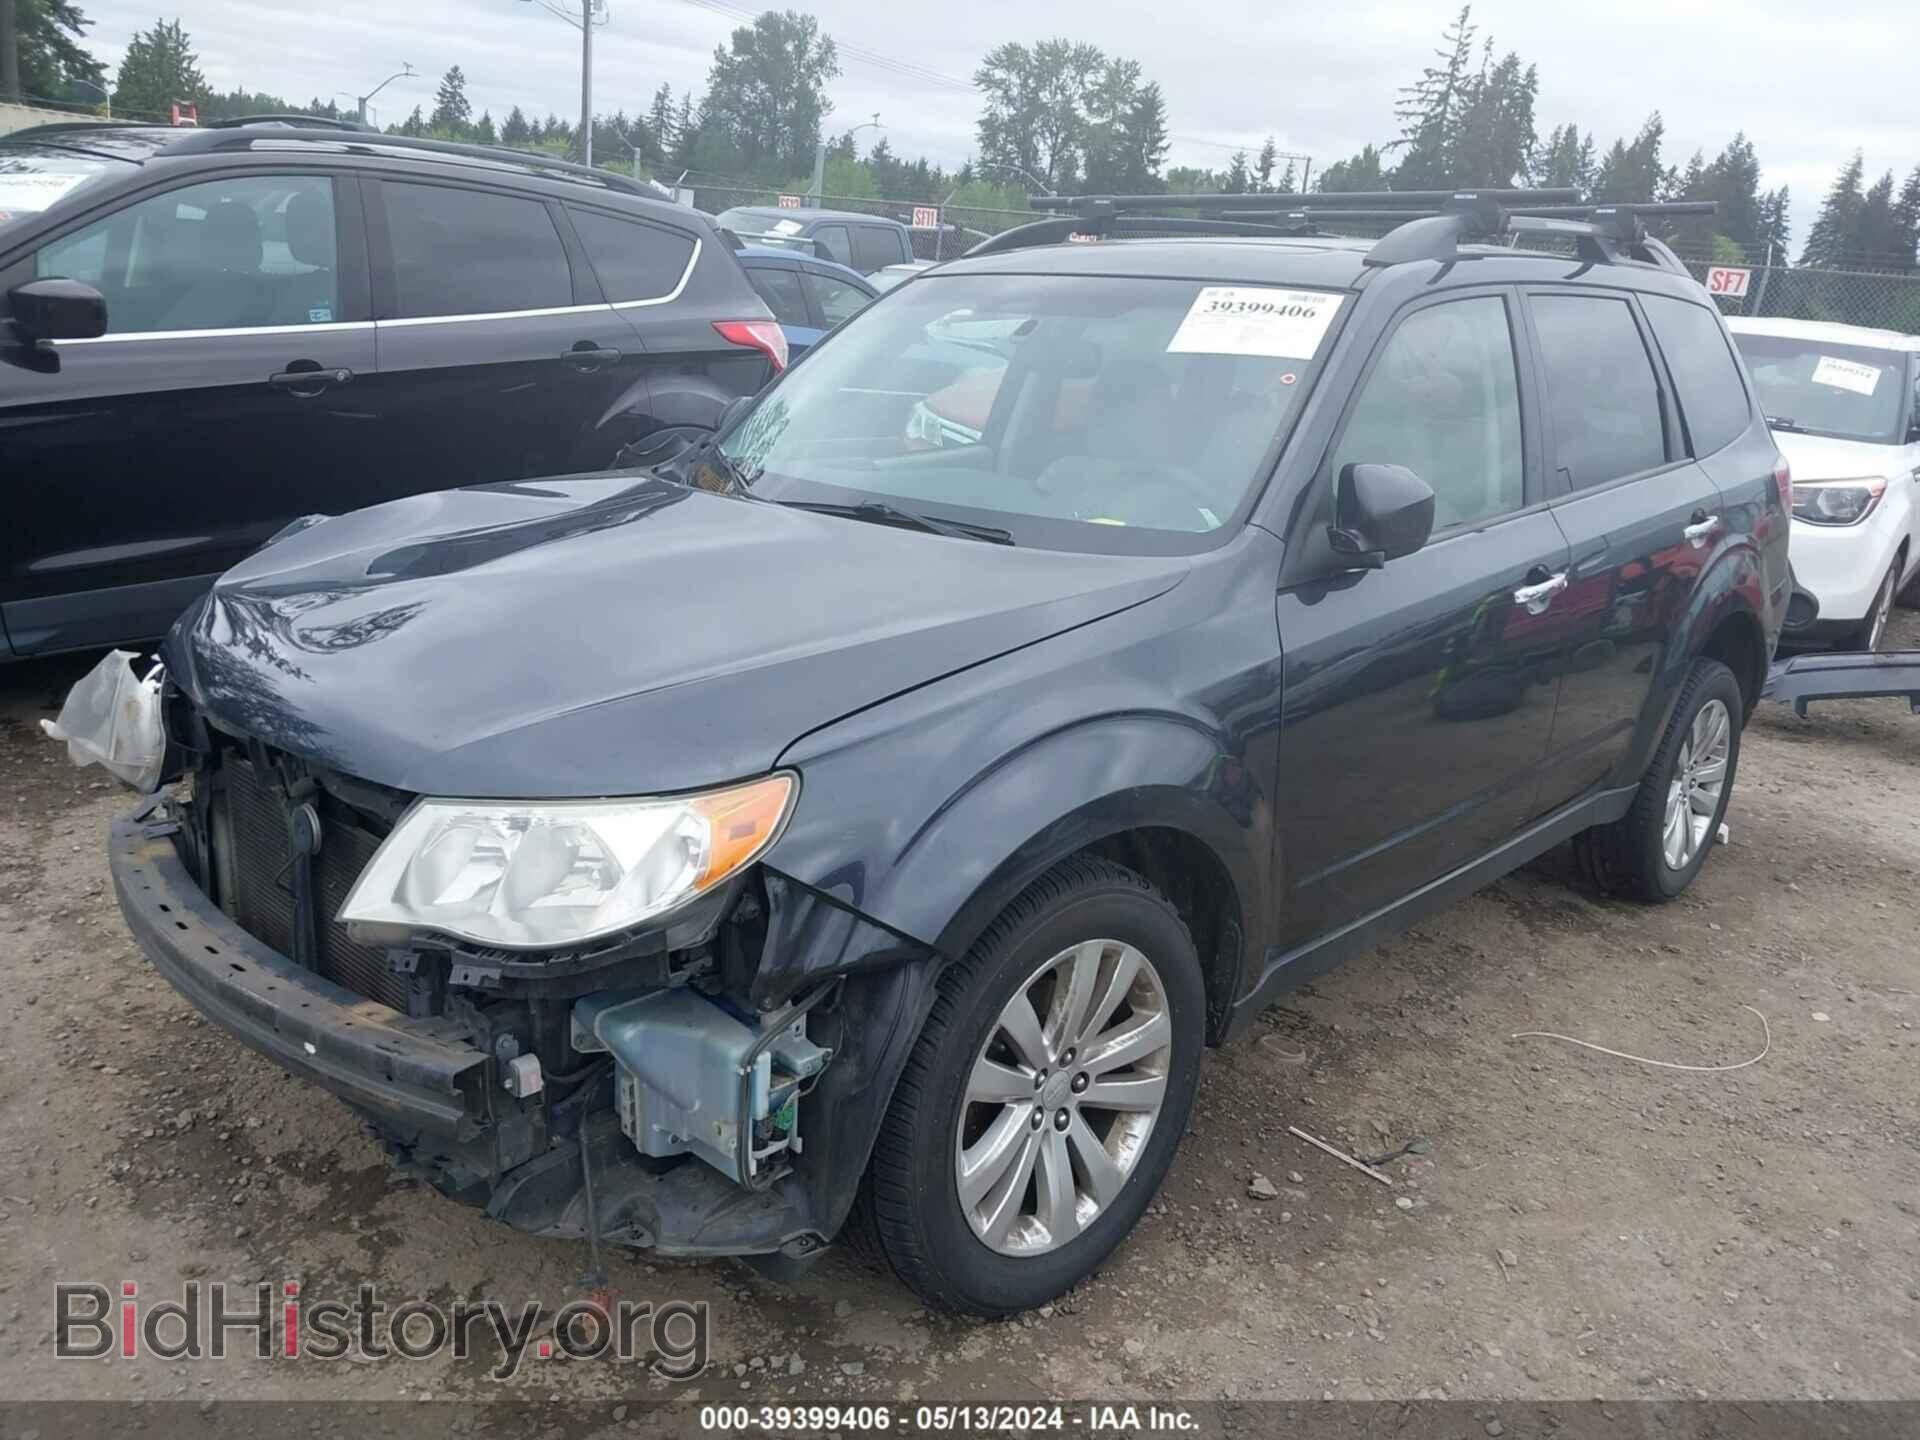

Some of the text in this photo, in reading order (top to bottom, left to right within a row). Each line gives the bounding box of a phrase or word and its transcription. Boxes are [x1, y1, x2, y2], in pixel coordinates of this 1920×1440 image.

[915, 209, 935, 225] SF11
[1710, 270, 1745, 292] SF7
[1203, 300, 1316, 318] 39399406
